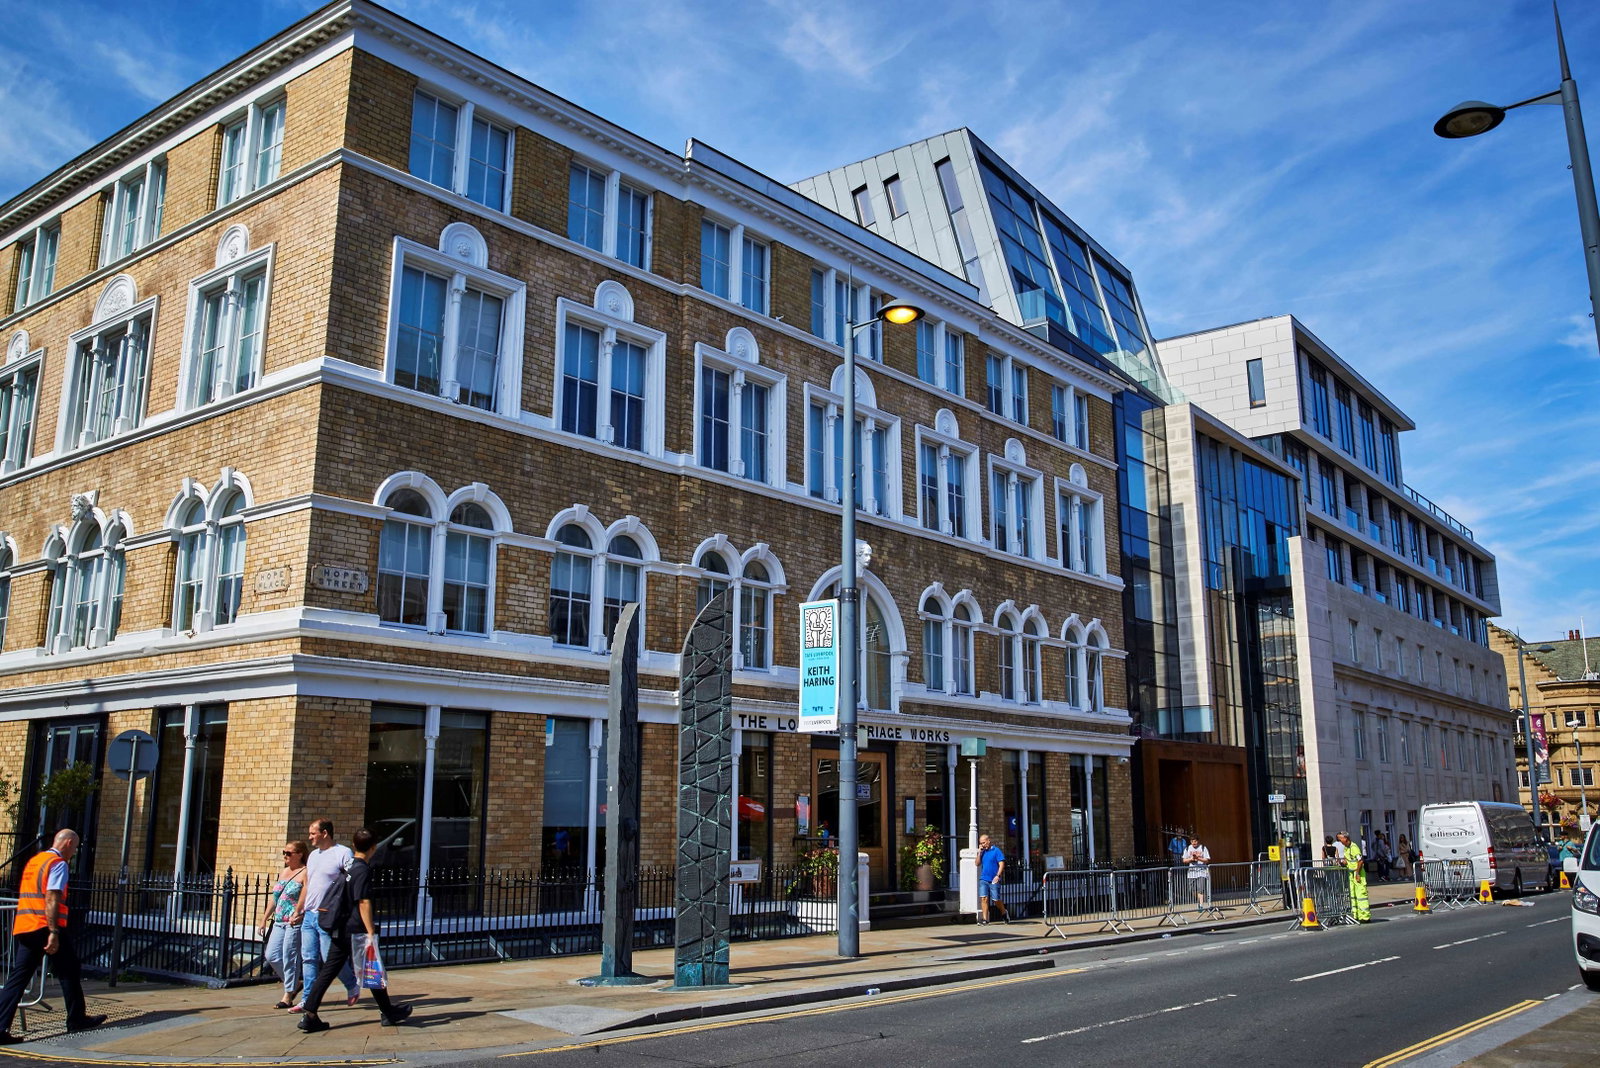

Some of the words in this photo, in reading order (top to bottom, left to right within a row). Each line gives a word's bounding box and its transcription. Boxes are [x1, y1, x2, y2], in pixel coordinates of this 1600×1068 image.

[260, 570, 284, 580] HOPE
[324, 569, 359, 580] HOPE
[319, 578, 363, 590] STREET
[807, 665, 830, 676] KEITH
[803, 676, 835, 687] HARING
[738, 714, 767, 729] THE
[910, 728, 950, 742] WORKS
[1430, 831, 1475, 839] ellisons
